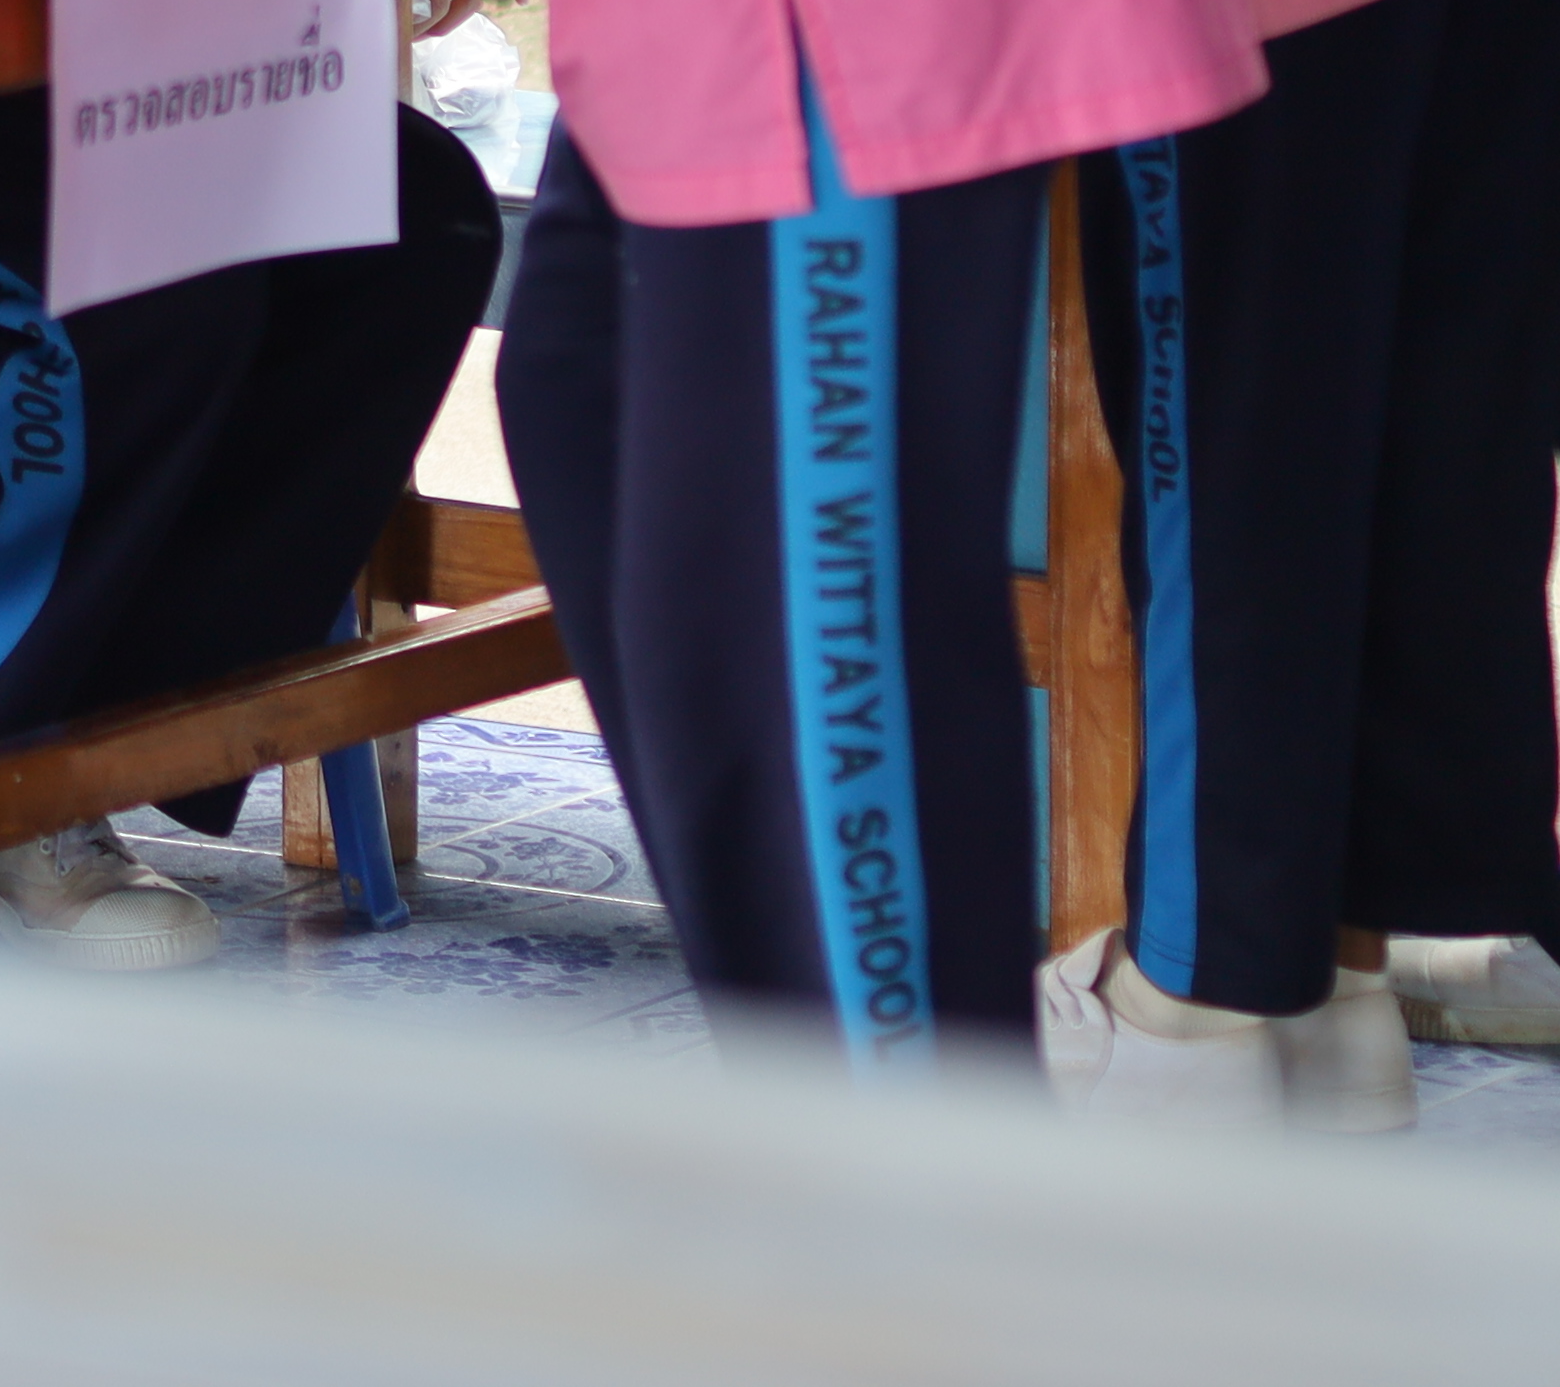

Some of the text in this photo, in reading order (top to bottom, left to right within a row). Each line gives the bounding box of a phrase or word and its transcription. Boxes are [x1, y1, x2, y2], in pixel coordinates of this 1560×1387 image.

[75, 1, 345, 148] ตรวจสอบรายชื่อ
[804, 239, 873, 463] RAHAN
[813, 491, 885, 784] WITTAYA
